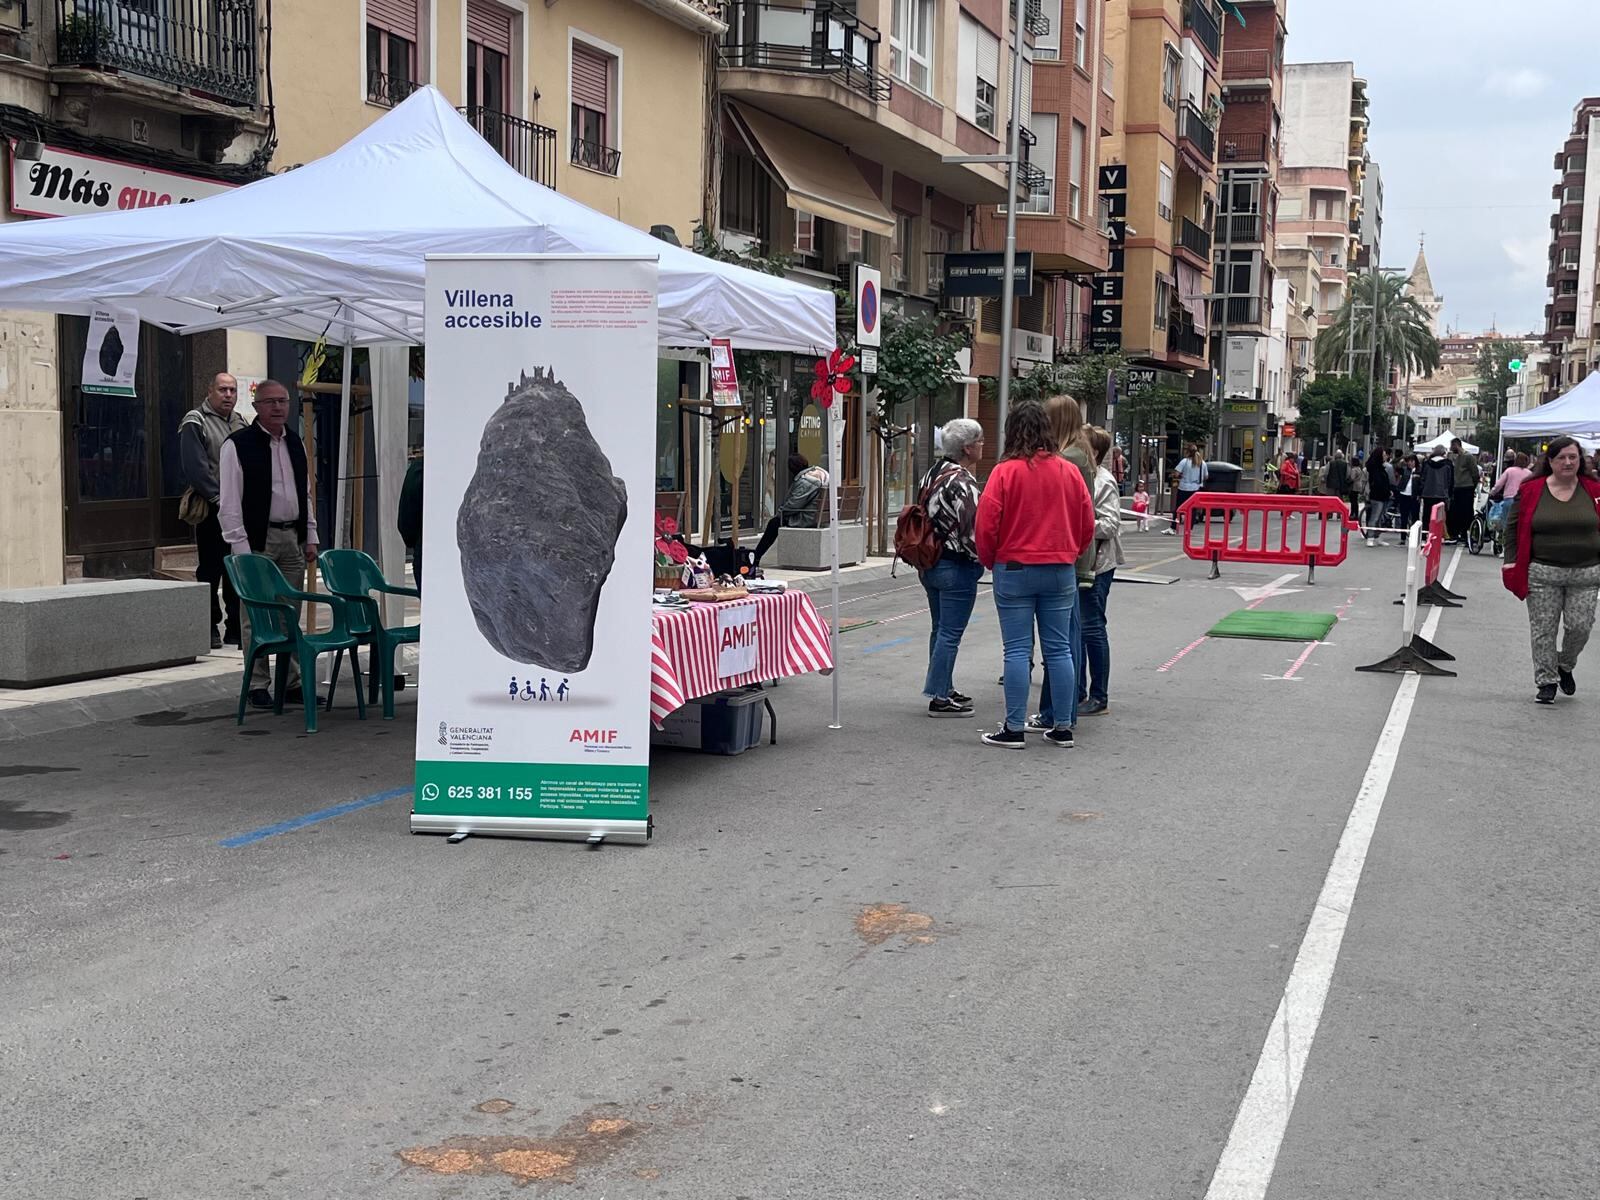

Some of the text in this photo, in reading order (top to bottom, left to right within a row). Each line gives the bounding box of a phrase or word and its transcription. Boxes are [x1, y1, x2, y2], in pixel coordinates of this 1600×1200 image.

[134, 124, 148, 142] 64
[29, 162, 112, 207] Más
[444, 289, 514, 308] Villena
[444, 311, 542, 328] accesible
[800, 415, 821, 429] LIFTING
[720, 621, 757, 653] AMIF
[569, 729, 618, 743] AMIF
[447, 785, 533, 800] 625 381 155
